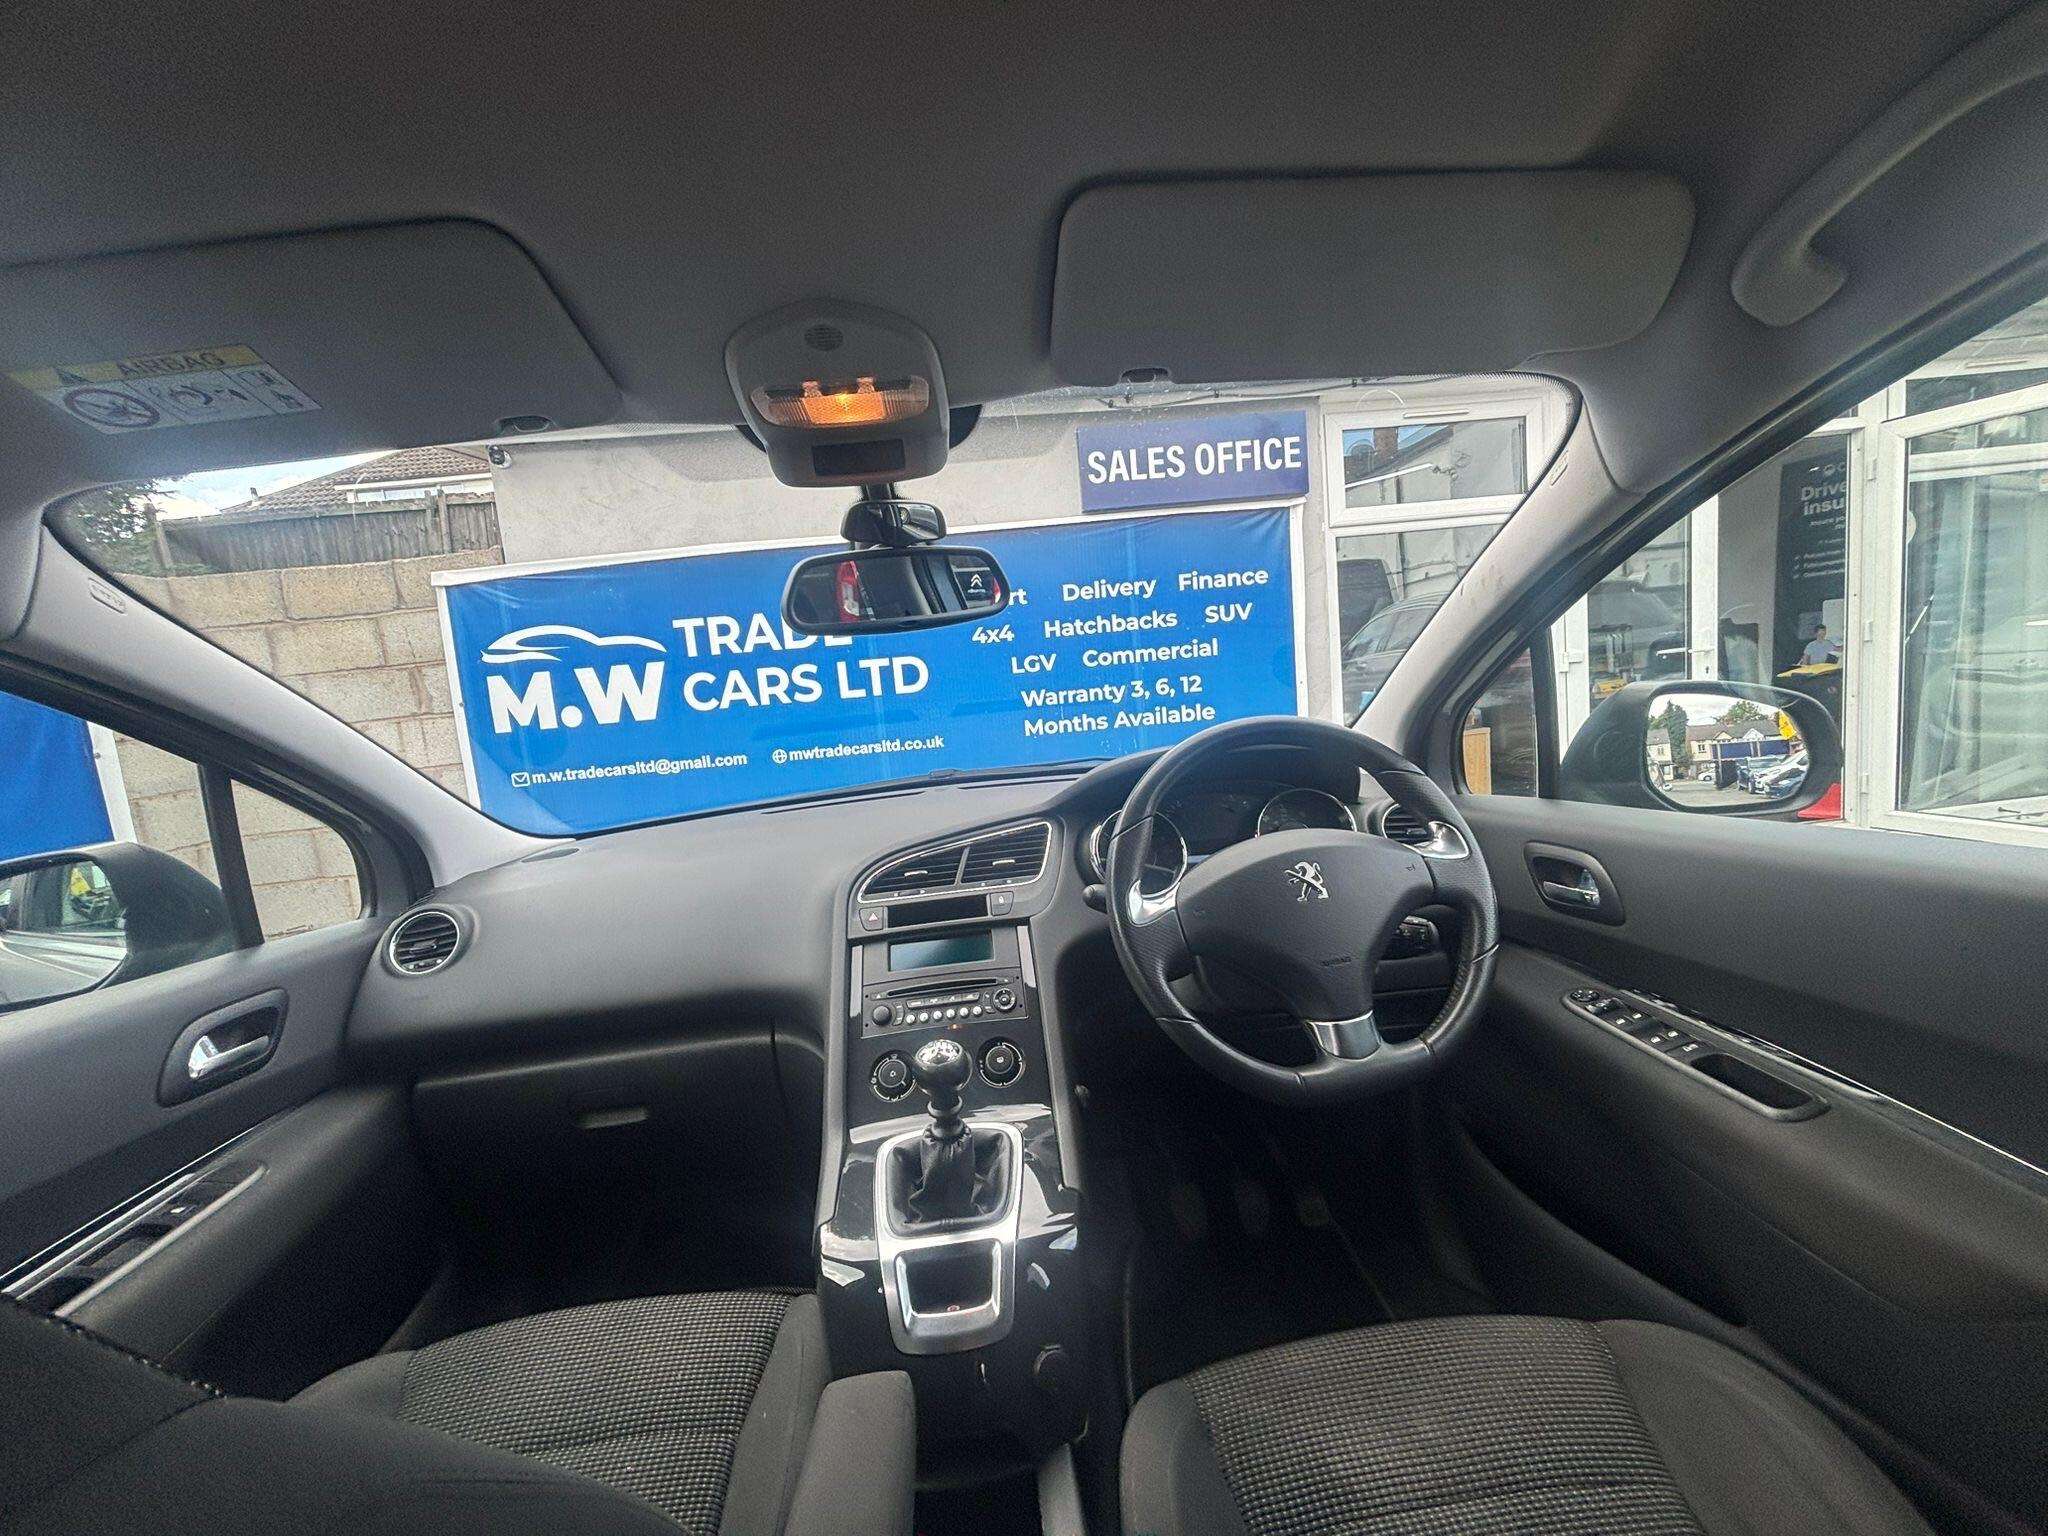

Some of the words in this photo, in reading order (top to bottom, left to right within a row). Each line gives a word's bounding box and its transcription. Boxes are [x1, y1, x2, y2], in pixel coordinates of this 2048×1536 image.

[1087, 445, 1186, 484] SALES
[1194, 436, 1302, 476] OFFICE
[1062, 578, 1157, 602] Delivery
[1178, 569, 1269, 592] Finance
[672, 612, 853, 658] TRAD
[971, 624, 1015, 644] 4x4
[1043, 611, 1178, 638] Hatchbacks
[1205, 602, 1253, 623] SUV
[1010, 653, 1057, 674] LGV
[1082, 637, 1219, 668] Commercial
[486, 661, 665, 734] M.W
[683, 663, 823, 712] CARS
[836, 655, 929, 700] LTD
[1020, 683, 1126, 708] Warranty
[1130, 680, 1151, 700] 3,
[1156, 678, 1176, 698] 6,
[1180, 675, 1203, 694] 12
[1023, 713, 1109, 737] Months
[1113, 703, 1216, 729] Available
[788, 735, 945, 763] mwtradecarsltd.co.uk
[532, 752, 748, 786] m.w.tradecarsltd@gmail.com
